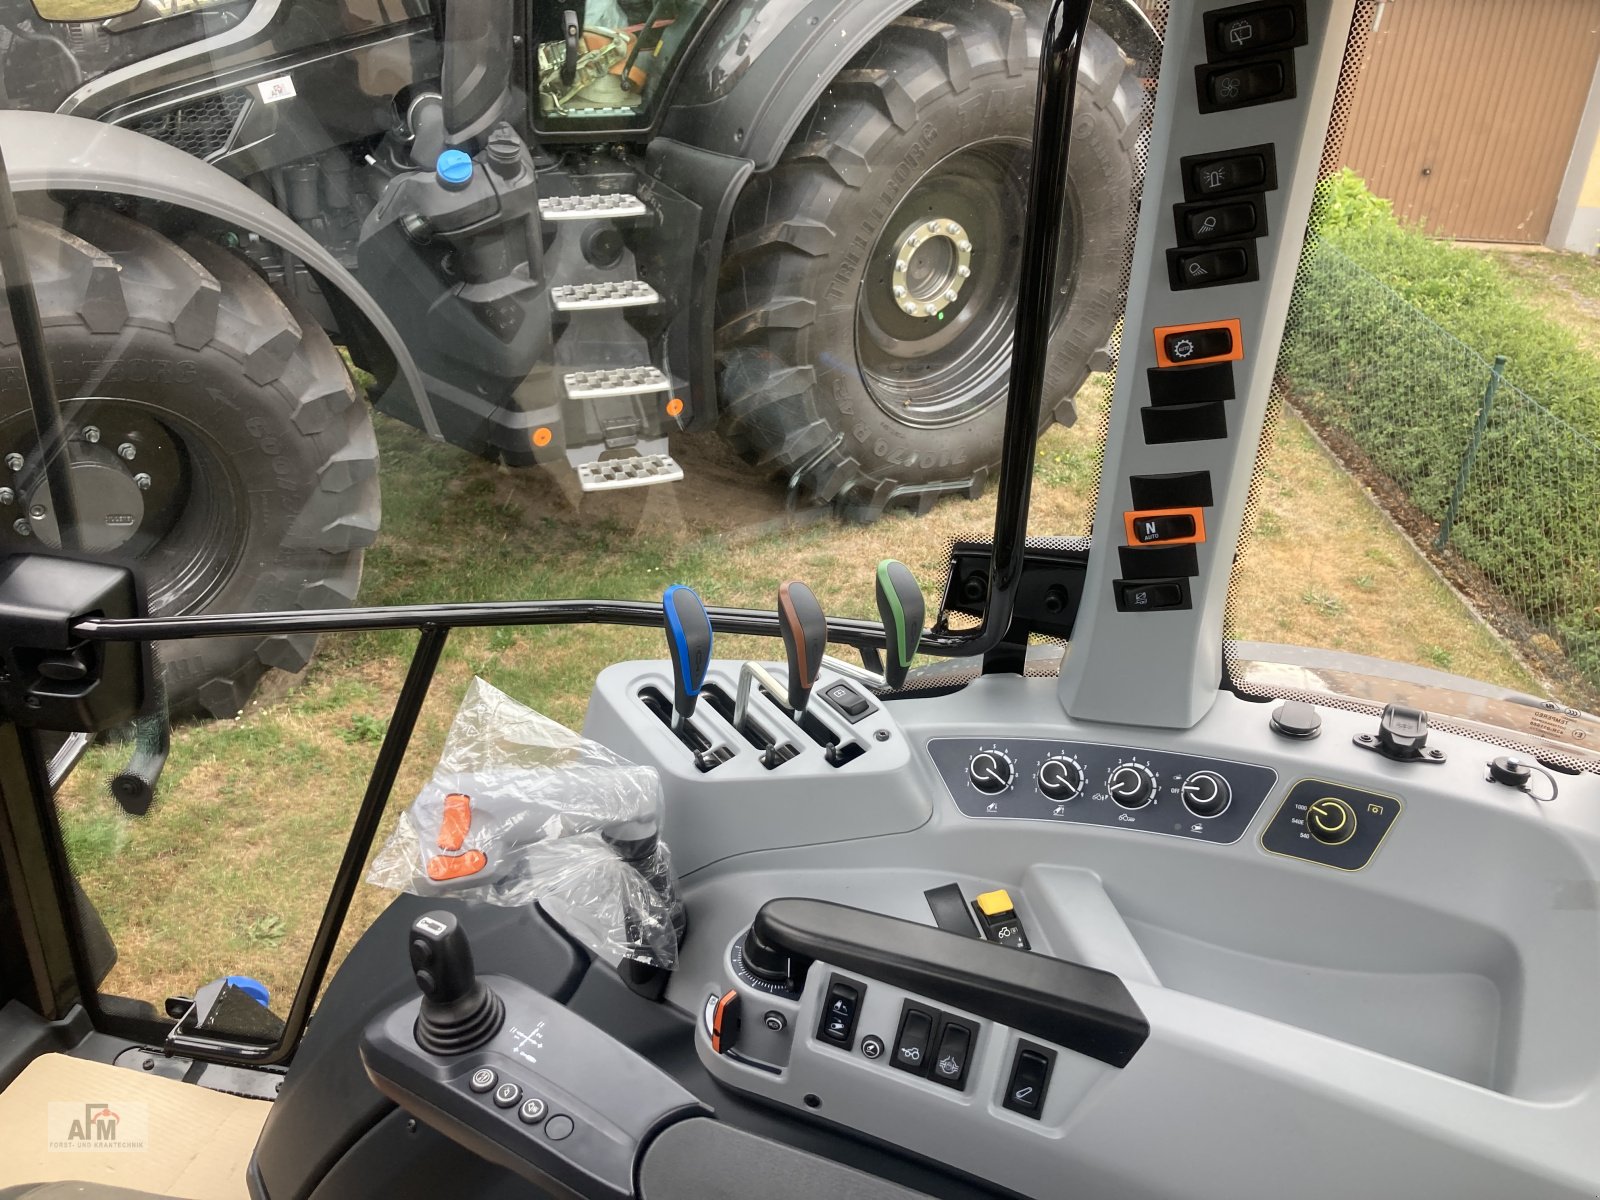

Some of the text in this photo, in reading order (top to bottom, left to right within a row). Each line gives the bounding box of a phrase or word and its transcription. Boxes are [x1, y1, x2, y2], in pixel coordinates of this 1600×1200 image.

[824, 122, 939, 300] TRELLEBORG
[1145, 521, 1156, 535] N
[1144, 533, 1159, 541] AUTO
[1295, 803, 1308, 811] 1000
[1291, 817, 1304, 826] 540E
